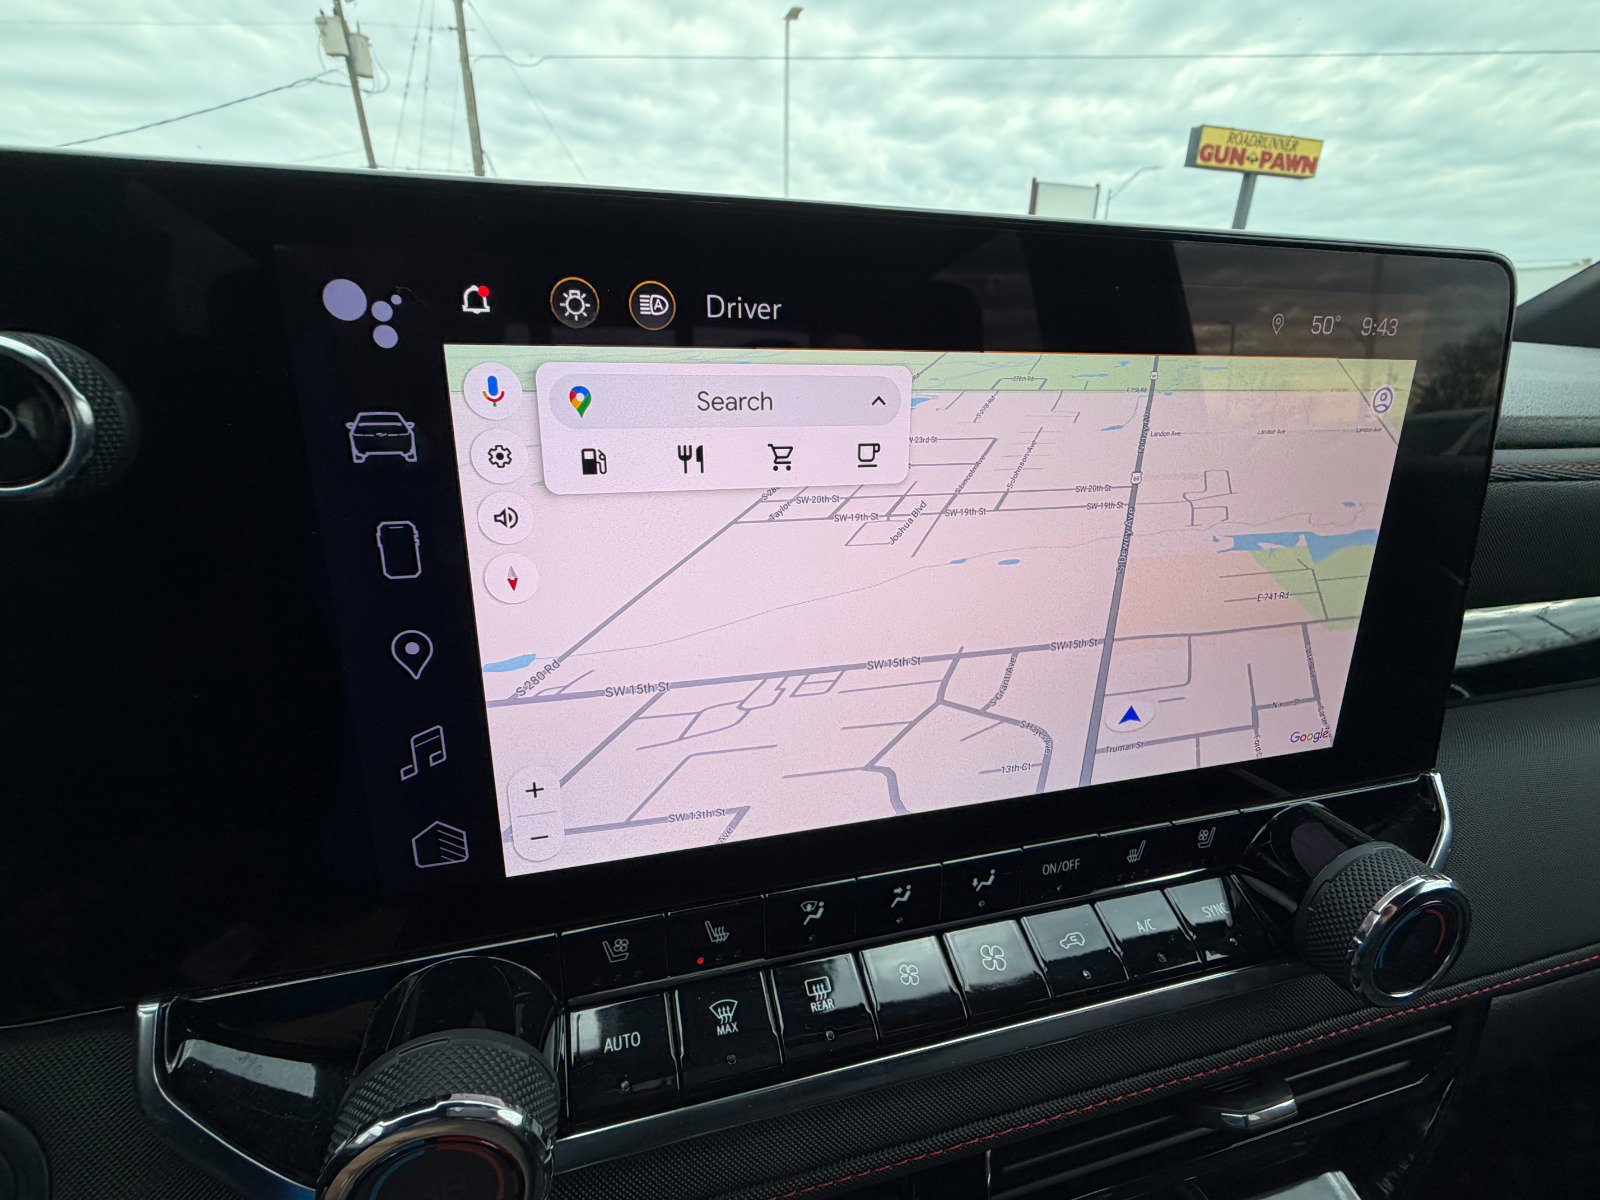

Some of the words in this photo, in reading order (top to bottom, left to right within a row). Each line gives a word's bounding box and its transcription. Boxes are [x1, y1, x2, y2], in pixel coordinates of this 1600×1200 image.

[1199, 144, 1247, 166] GUN
[1258, 150, 1319, 174] PAWN
[706, 294, 782, 320] Driver
[1311, 315, 1341, 335] 50°
[1361, 317, 1398, 336] 9:43
[697, 390, 773, 411] Search
[1010, 453, 1030, 486] Johnson
[1027, 439, 1037, 453] Ave
[1075, 485, 1086, 493] SW
[1104, 484, 1112, 492] St
[795, 496, 810, 505] SW
[812, 495, 830, 504] 20th
[831, 494, 840, 503] St
[1086, 502, 1098, 510] SW
[1100, 501, 1115, 510] 19th
[1116, 501, 1124, 509] St
[769, 500, 791, 520] Taylor
[834, 514, 847, 523] SW
[851, 513, 868, 522] 19th
[870, 512, 879, 521] St
[944, 509, 957, 517] SW
[960, 508, 977, 516] 19th
[978, 507, 987, 515] St
[1124, 507, 1136, 527] Ave
[890, 516, 914, 546] Joshua
[911, 500, 928, 519] Blvd
[1118, 529, 1134, 564] Dewey
[1279, 591, 1289, 600] Rd
[1050, 642, 1066, 652] SW
[1068, 639, 1087, 650] 15th
[1088, 638, 1098, 648] St
[866, 660, 885, 671] SW
[887, 657, 909, 668] 15th
[910, 656, 922, 667] St
[1006, 657, 1017, 674] Ave
[524, 671, 545, 691] 280
[543, 658, 561, 676] Rd
[605, 686, 626, 698] SW
[630, 683, 655, 696] 15th
[657, 681, 671, 693] St
[1290, 728, 1329, 743] Google
[1105, 743, 1134, 754] Truman
[1135, 741, 1144, 750] St
[1001, 764, 1020, 774] 13th
[1021, 762, 1031, 771] Ct
[667, 813, 686, 823] SW
[689, 810, 713, 821] 13th
[715, 808, 726, 817] St
[716, 826, 734, 844] Ave
[1041, 858, 1081, 876] ON/OFF
[1201, 902, 1230, 918] SYNC
[1135, 918, 1157, 933] A/C
[810, 998, 836, 1013] REAR
[716, 1021, 740, 1037] MAX
[603, 1031, 642, 1054] AUTO
